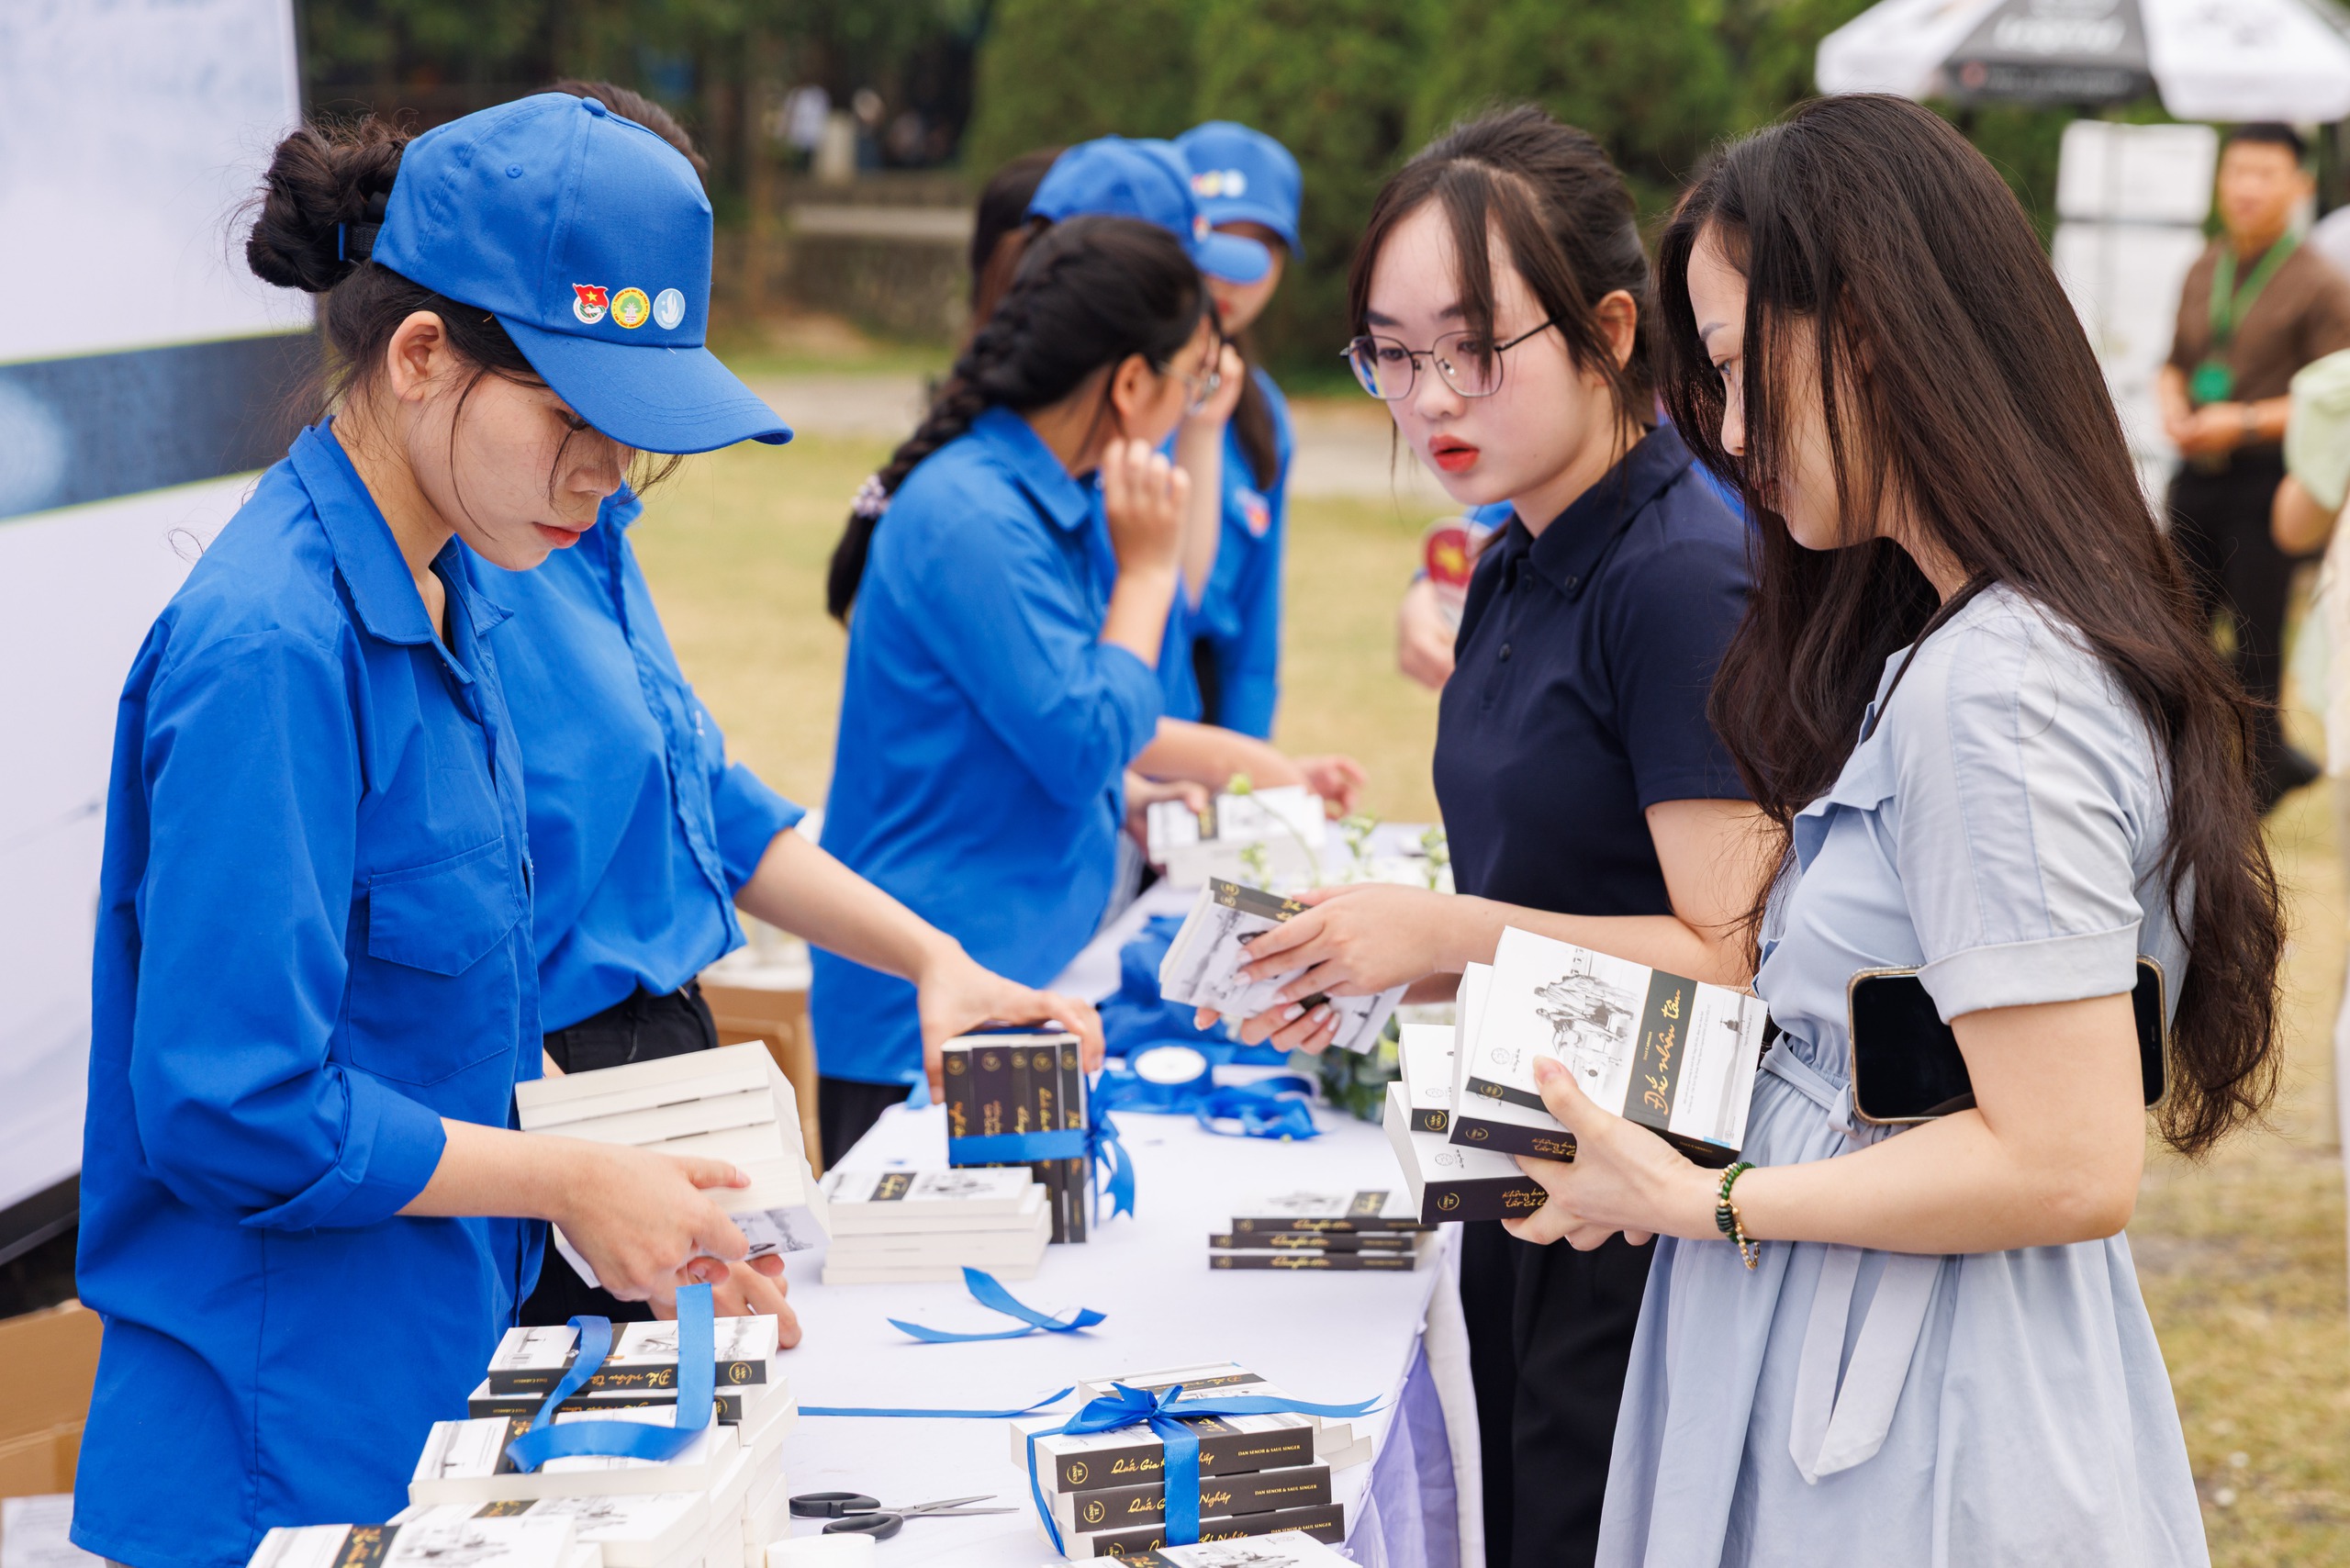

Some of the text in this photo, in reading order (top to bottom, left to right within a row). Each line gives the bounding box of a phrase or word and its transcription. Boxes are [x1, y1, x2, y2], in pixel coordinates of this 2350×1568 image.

[1643, 989, 1681, 1115] Đắc nhân tâm
[590, 1373, 606, 1386] tâ
[1111, 1458, 1140, 1474] Quốc
[1139, 1458, 1160, 1471] Gia
[1127, 1497, 1157, 1513] Quốc
[1199, 1491, 1232, 1507] Nghiệp
